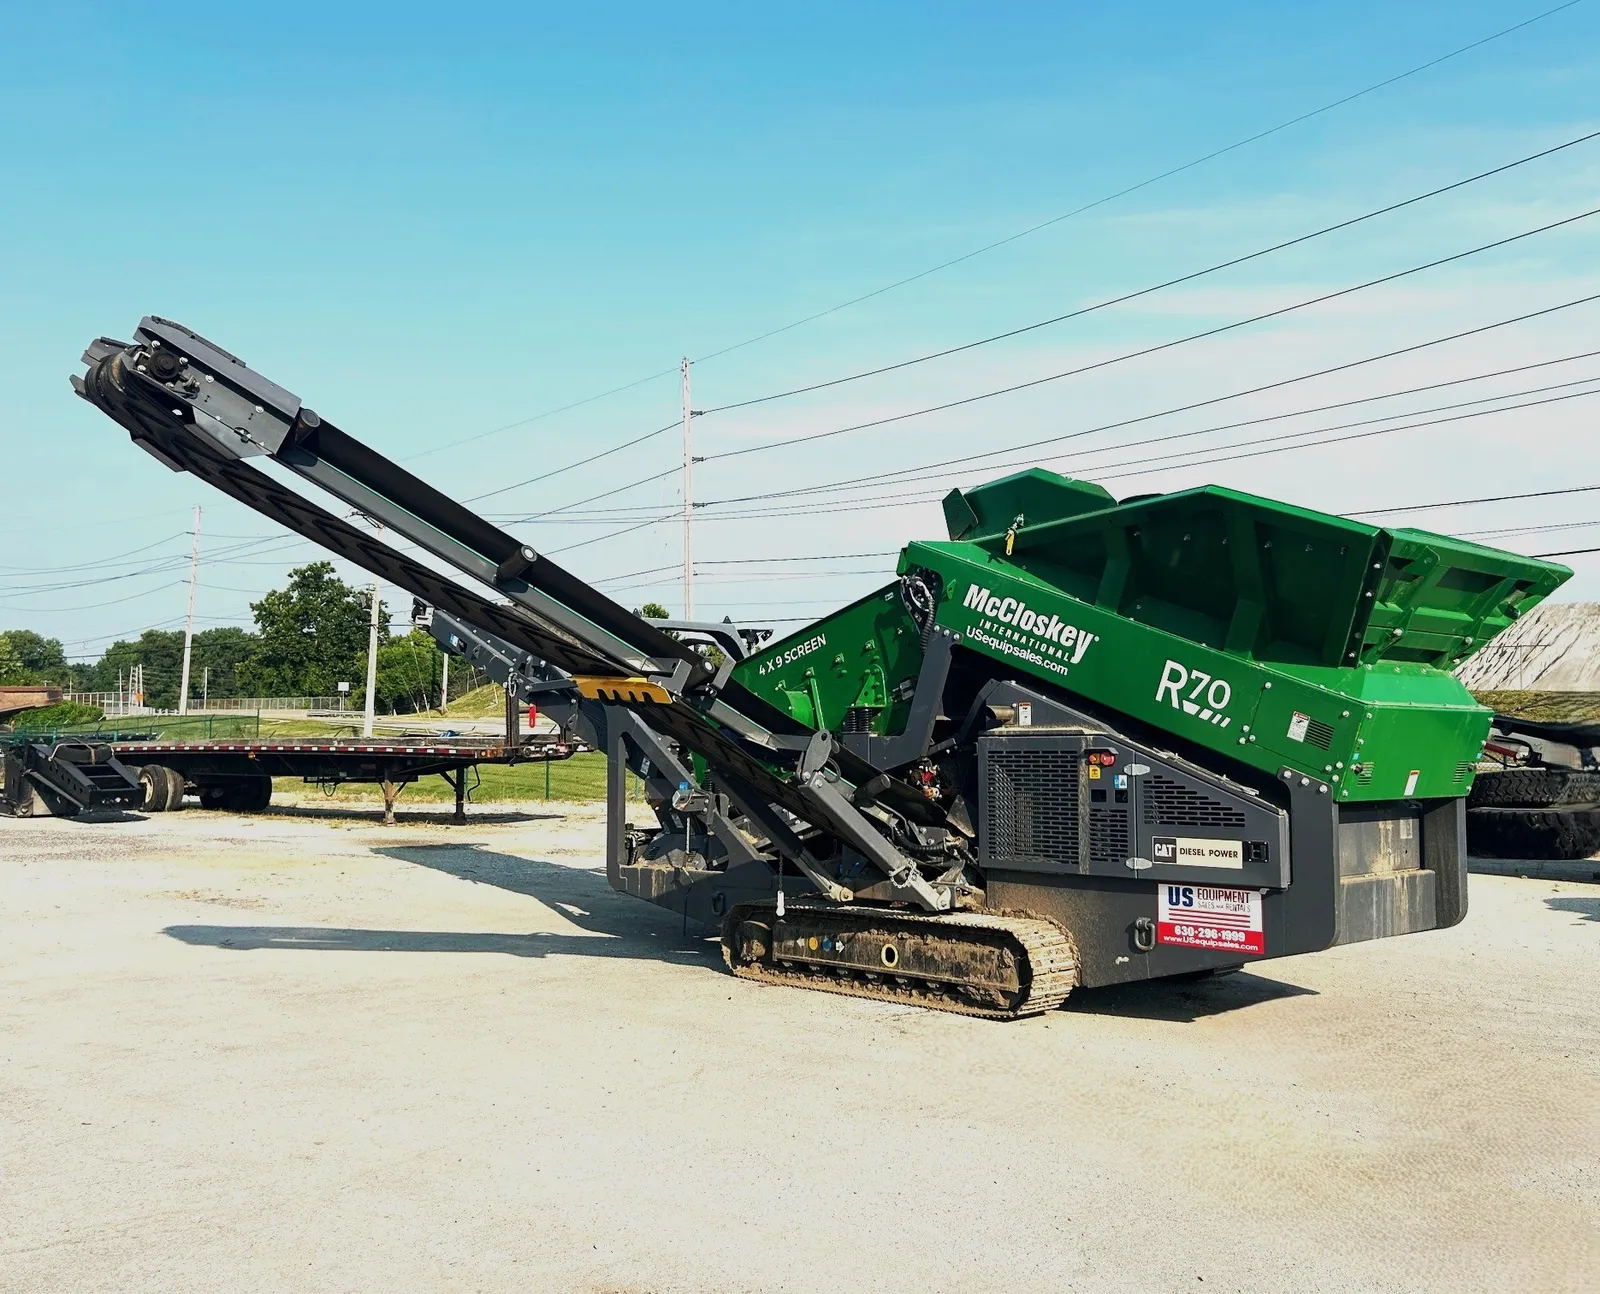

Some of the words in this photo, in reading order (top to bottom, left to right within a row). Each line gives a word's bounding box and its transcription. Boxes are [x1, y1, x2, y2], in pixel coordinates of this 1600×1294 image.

[962, 583, 1095, 665] McCloskey
[978, 618, 1071, 663] INTERNATIONAL
[758, 664, 766, 676] 4
[767, 659, 775, 674] X
[775, 655, 783, 668] 9
[784, 633, 827, 664] SCREEN
[966, 625, 1069, 676] USequipsales.com
[1155, 659, 1232, 711] R70
[1154, 843, 1176, 857] CAT
[1179, 847, 1205, 857] DIESEL
[1208, 849, 1239, 859] POWER
[1168, 885, 1194, 908] US
[1197, 888, 1251, 904] EQUIPMENT
[1163, 935, 1259, 951] www.USequipsales.com
